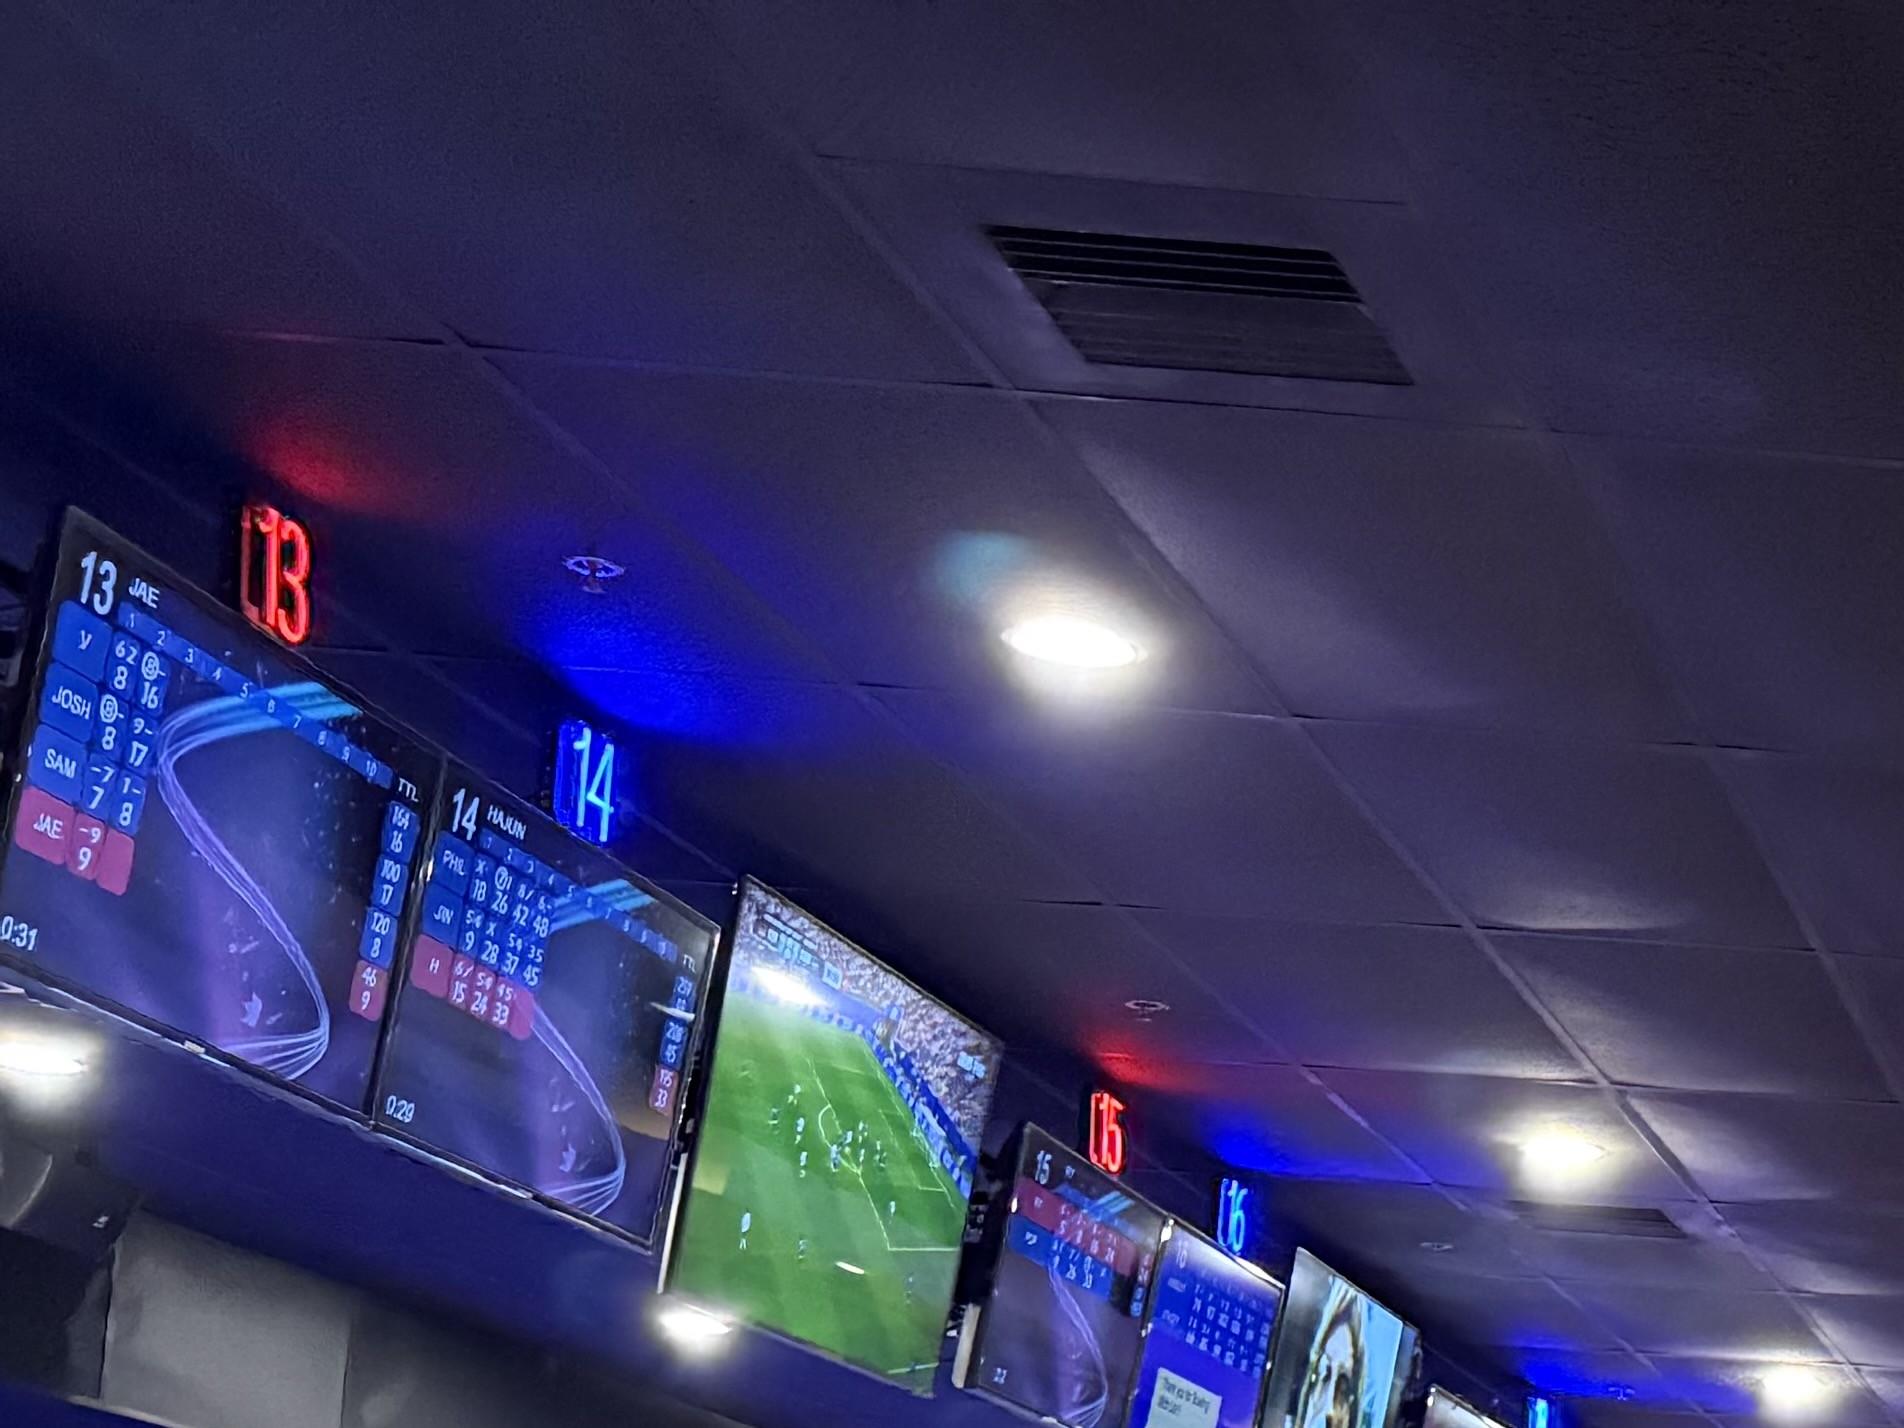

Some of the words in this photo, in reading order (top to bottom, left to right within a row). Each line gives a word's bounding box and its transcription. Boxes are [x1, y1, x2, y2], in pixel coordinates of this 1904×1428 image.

[80, 551, 118, 615] 13
[128, 578, 160, 608] JAE
[259, 506, 311, 643] 13
[115, 639, 138, 666] 62
[113, 666, 128, 690] 8
[141, 684, 159, 710] 16
[157, 630, 165, 646] 2
[185, 648, 194, 664] 3
[240, 681, 249, 698] 5
[293, 714, 302, 728] 7
[367, 760, 377, 777] 10
[102, 726, 117, 751] 8
[129, 741, 148, 768] 17
[51, 685, 92, 720] JOSH
[380, 862, 401, 884] 100
[452, 788, 481, 841] 14
[573, 726, 616, 843] 14
[44, 748, 77, 779] SAM
[371, 911, 391, 935] 120
[90, 786, 104, 810] 7
[118, 802, 132, 827] 8
[370, 938, 381, 959] 8
[32, 812, 64, 840] JAE
[361, 965, 378, 989] 46
[78, 847, 92, 872] 9
[360, 990, 371, 1012] 9
[470, 878, 487, 901] 18
[491, 891, 509, 915] 26
[513, 905, 530, 926] 42
[533, 917, 549, 939] 48
[1, 916, 38, 952] 0:31
[465, 931, 475, 951] 9
[481, 941, 499, 965] 28
[502, 954, 520, 975] 37
[523, 966, 540, 988] 45
[528, 945, 543, 963] 35
[430, 958, 440, 974] H
[452, 980, 468, 1004] 15
[471, 991, 488, 1015] 24
[492, 1002, 509, 1026] 33
[1099, 1091, 1126, 1173] 15
[1036, 1150, 1051, 1184] 15
[1227, 1180, 1248, 1252] 16
